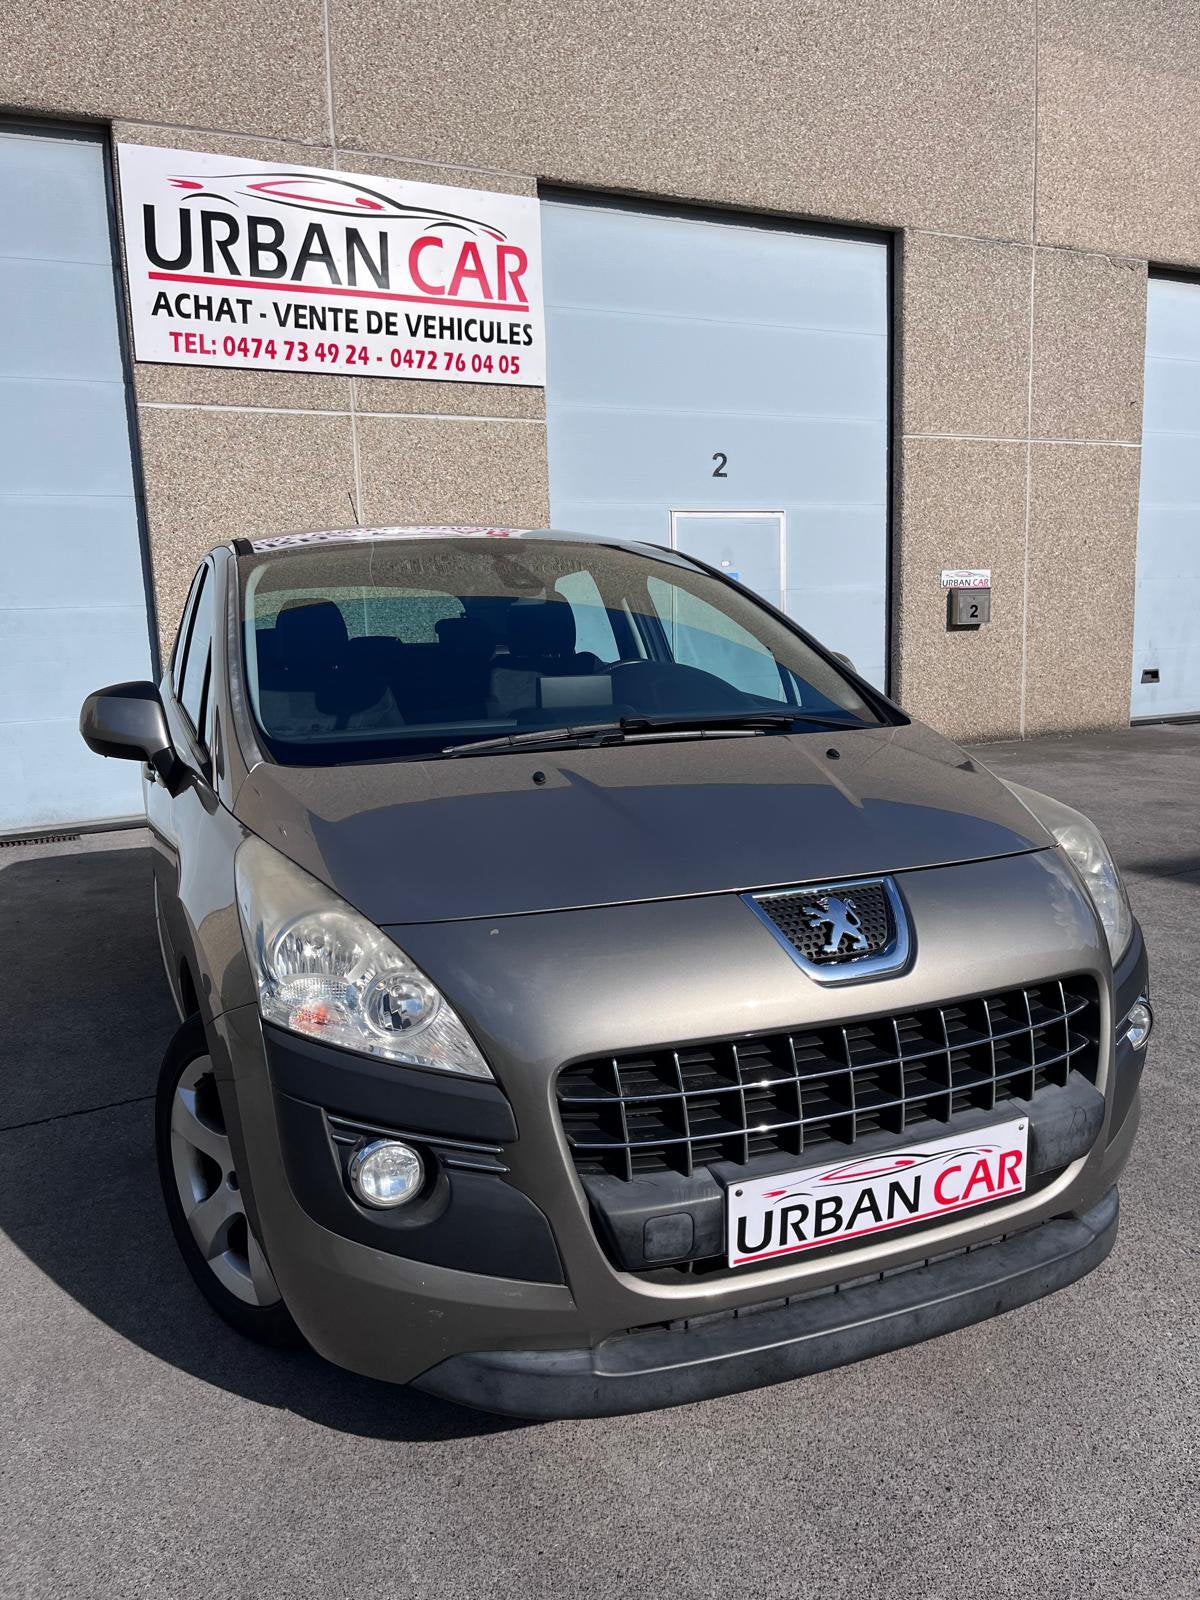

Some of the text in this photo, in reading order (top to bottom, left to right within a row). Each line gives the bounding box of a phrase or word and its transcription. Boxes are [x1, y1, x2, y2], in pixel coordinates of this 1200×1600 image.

[143, 204, 528, 302] URBAN CAR
[152, 291, 252, 324] ACHAT
[272, 301, 357, 334] VENTE
[366, 310, 398, 336] DE
[405, 313, 532, 346] VEHICULES
[169, 331, 217, 355] TEL:
[223, 336, 276, 360] 0474
[284, 341, 308, 362] 73
[314, 342, 339, 364] 49
[346, 344, 369, 365] 24
[390, 347, 437, 370] 0472
[444, 351, 467, 371] 76
[472, 353, 495, 373] 04
[499, 354, 520, 374] 05
[712, 452, 728, 478] 2
[970, 605, 978, 618] 2
[737, 1150, 1023, 1254] URBAN CAR
